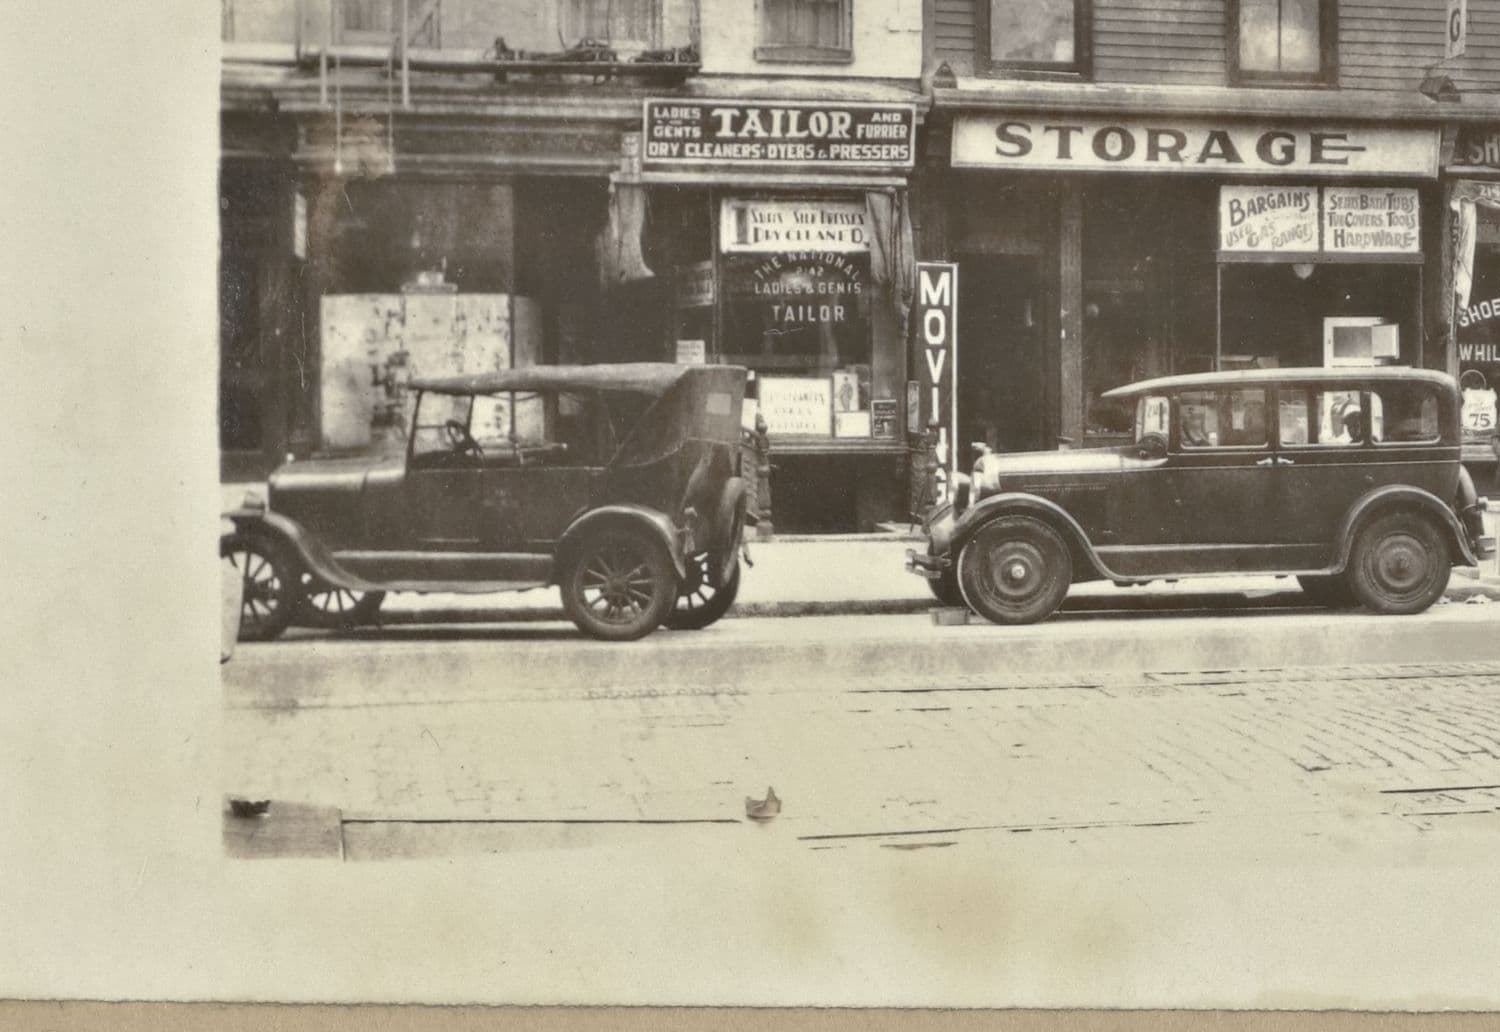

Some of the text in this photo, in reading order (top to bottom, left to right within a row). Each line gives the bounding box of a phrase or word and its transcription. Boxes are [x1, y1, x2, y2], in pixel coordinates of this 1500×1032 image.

[653, 107, 701, 119] LADIES
[871, 112, 902, 123] AND
[653, 125, 701, 138] GENTS
[711, 108, 852, 139] TAILOR
[856, 123, 909, 139] FURRIER
[648, 141, 679, 157] DRY
[684, 142, 760, 159] CLEANERS
[767, 143, 815, 159] DYERS
[829, 144, 910, 160] PRESSERS
[994, 121, 1367, 166] STORAGE
[1229, 191, 1310, 226] BARGAINS
[1345, 212, 1383, 227] COVERS
[1386, 211, 1416, 229] TOOLS
[753, 227, 780, 243] DRY
[1333, 229, 1416, 248] HARDWARE
[754, 252, 861, 281] THE NATIONAL
[754, 282, 801, 295] LADIES
[818, 282, 862, 295] GENTS
[772, 306, 845, 322] TAILOR
[1469, 413, 1491, 428] 75
